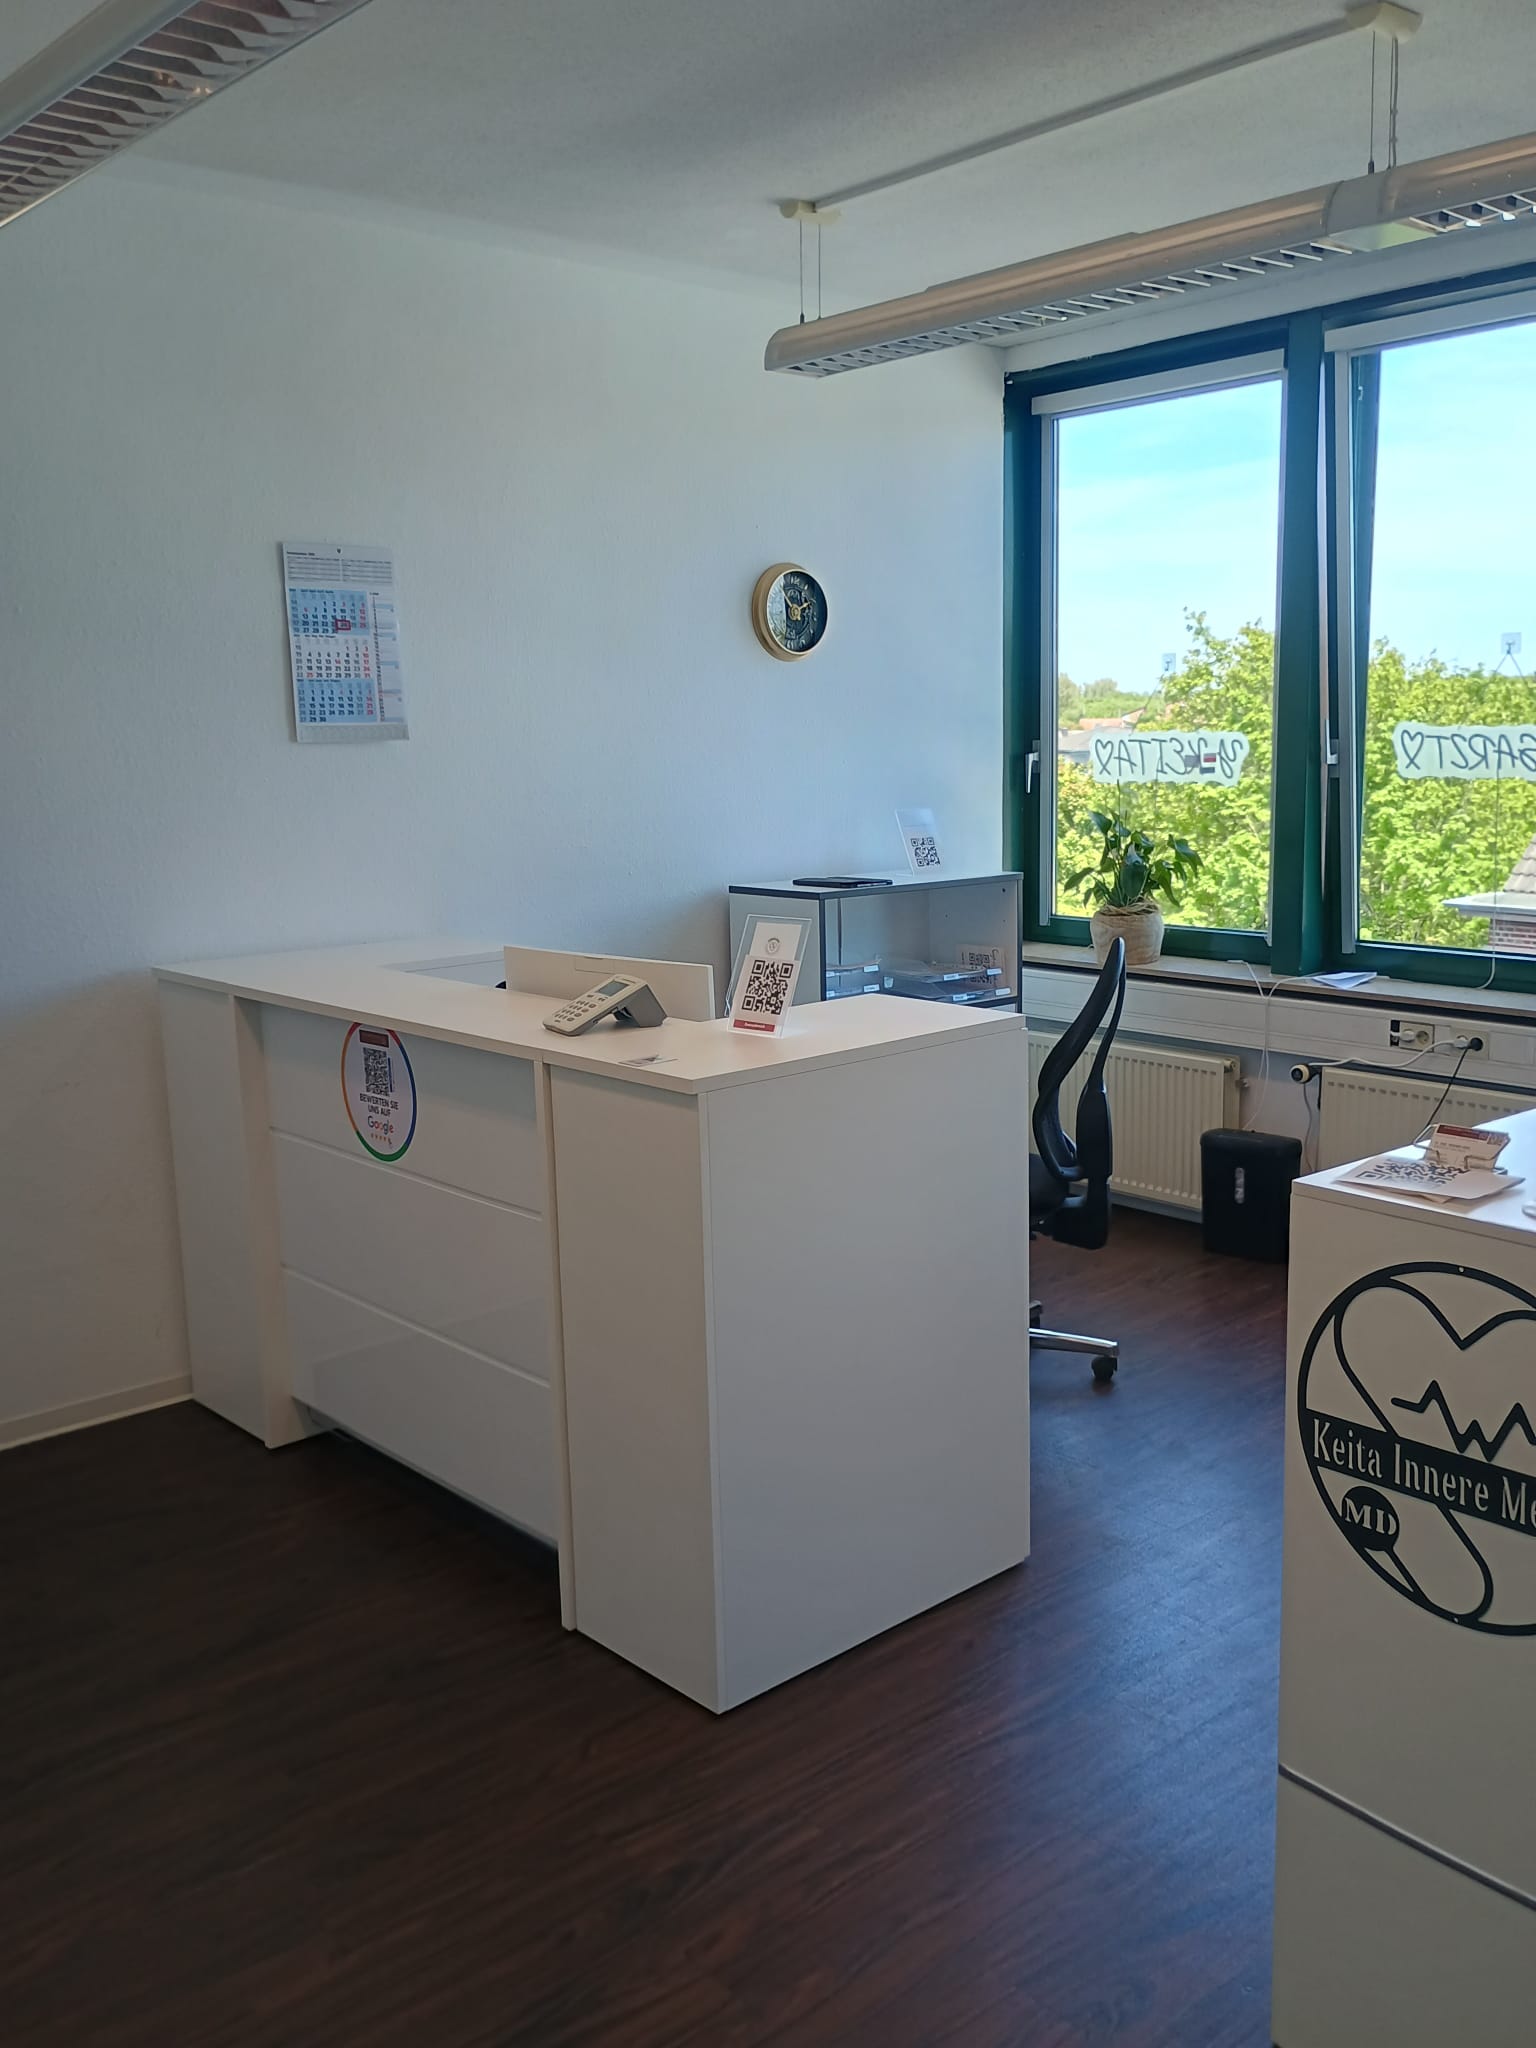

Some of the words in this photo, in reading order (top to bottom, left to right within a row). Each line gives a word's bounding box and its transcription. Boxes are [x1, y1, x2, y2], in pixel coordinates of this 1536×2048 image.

[359, 1093, 389, 1107] BEWERTEN
[390, 1100, 399, 1110] SIE
[368, 1104, 379, 1114] UNS
[380, 1107, 391, 1117] AUF
[367, 1115, 394, 1135] Google
[1314, 1418, 1382, 1478] Keita
[1394, 1442, 1489, 1512] Innere
[1344, 1497, 1397, 1536] MD
